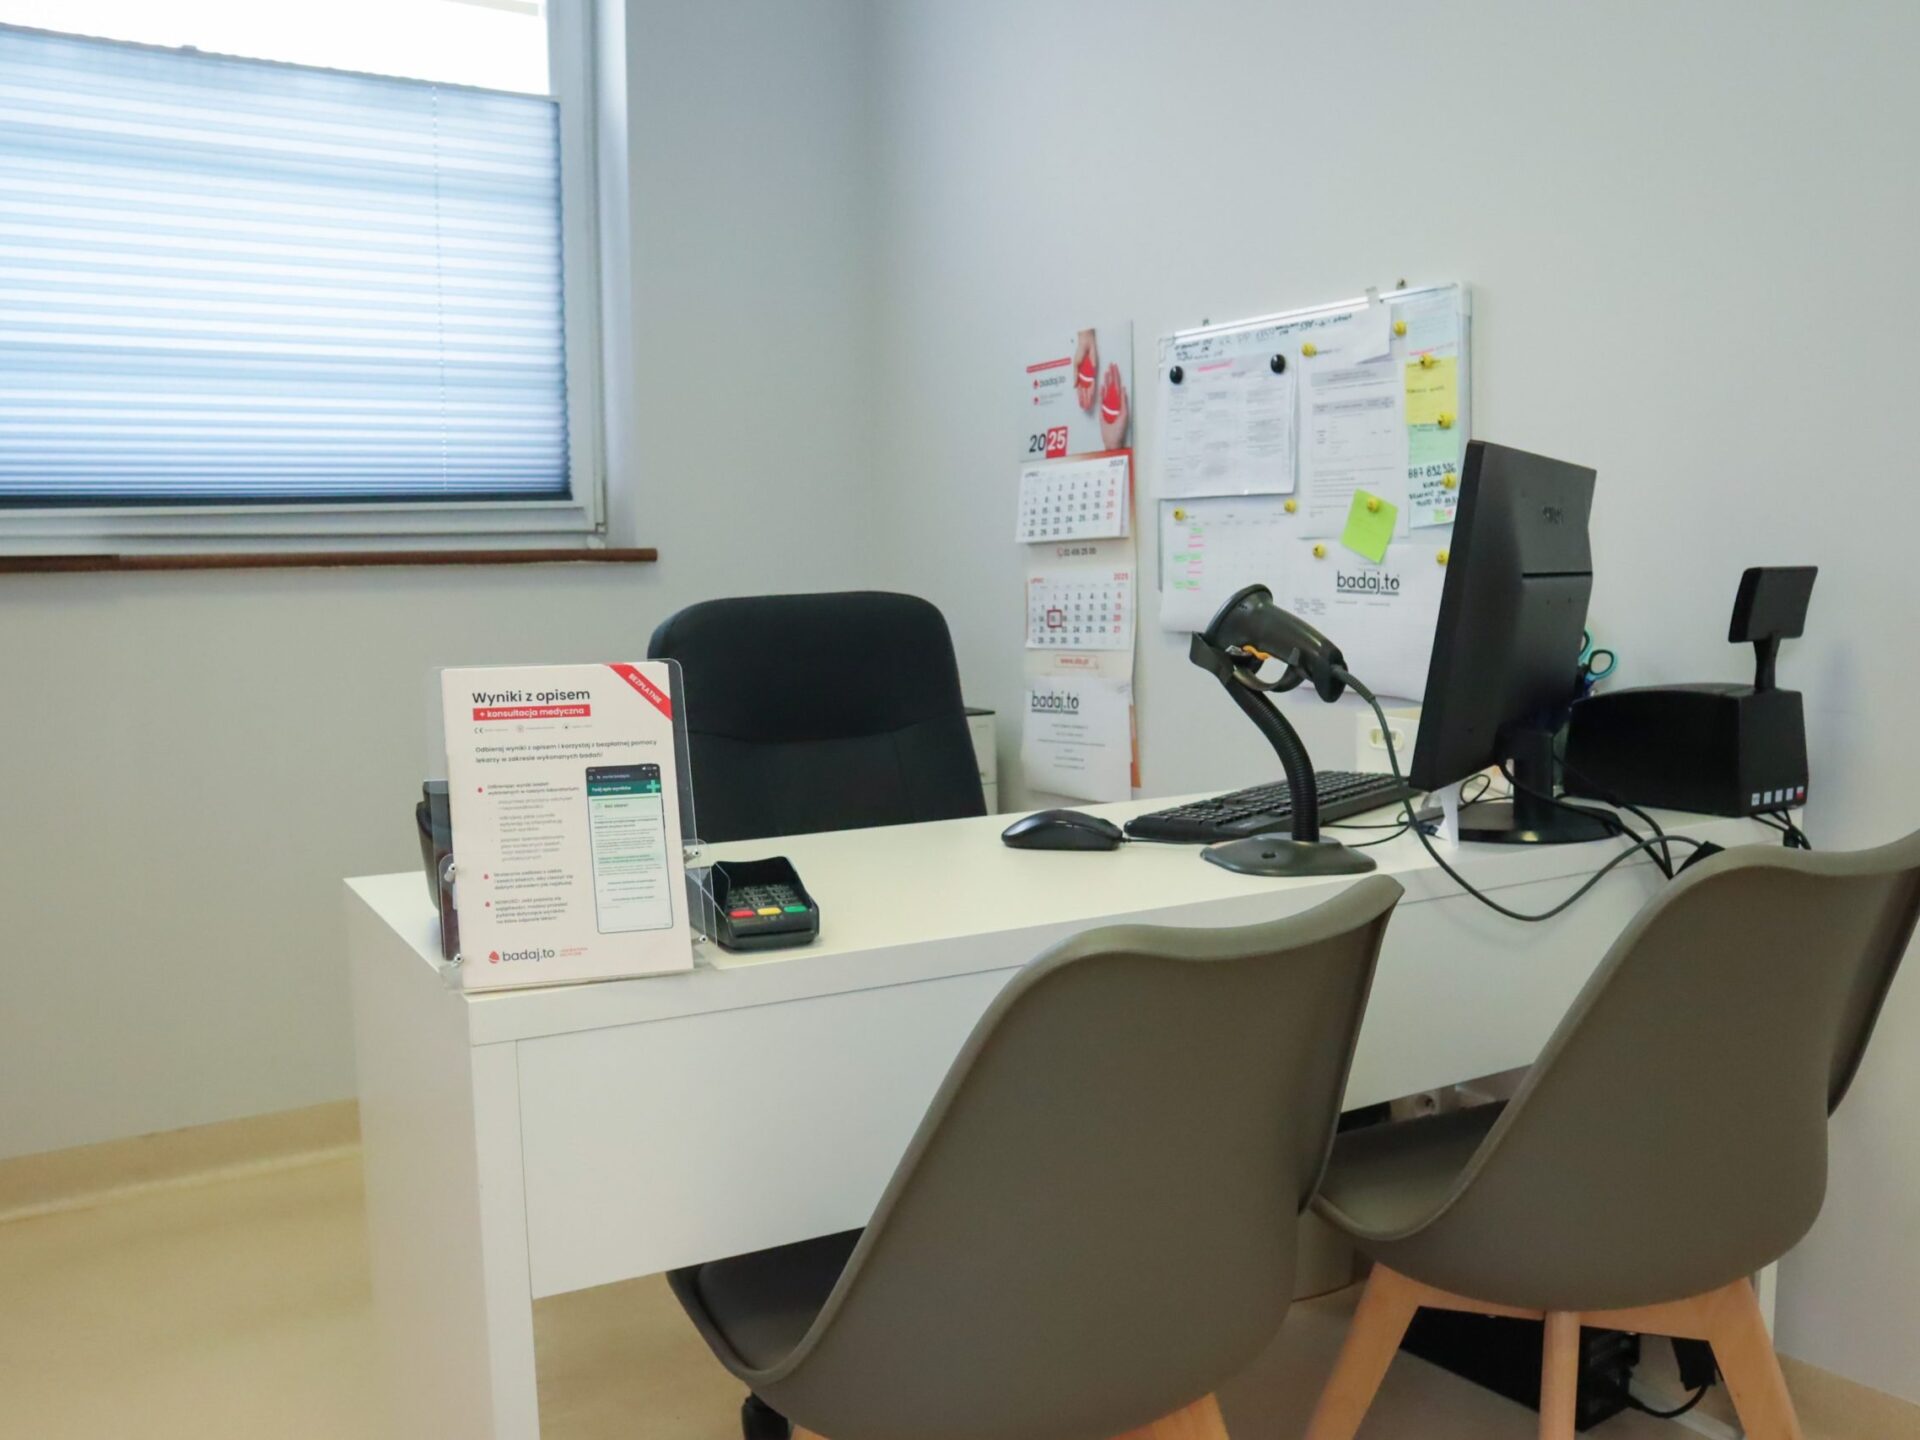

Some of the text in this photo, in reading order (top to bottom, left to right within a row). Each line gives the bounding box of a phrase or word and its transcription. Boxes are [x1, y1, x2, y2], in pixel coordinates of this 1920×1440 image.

[1029, 430, 1066, 453] 2025
[1337, 570, 1400, 594] badaj.to
[472, 689, 590, 706] Wyniki z opisem
[1031, 689, 1079, 712] badaj.to
[487, 708, 538, 718] konsultacja
[540, 707, 584, 717] medyczna
[536, 754, 578, 762] wykonanych
[502, 948, 555, 962] badaj.to
